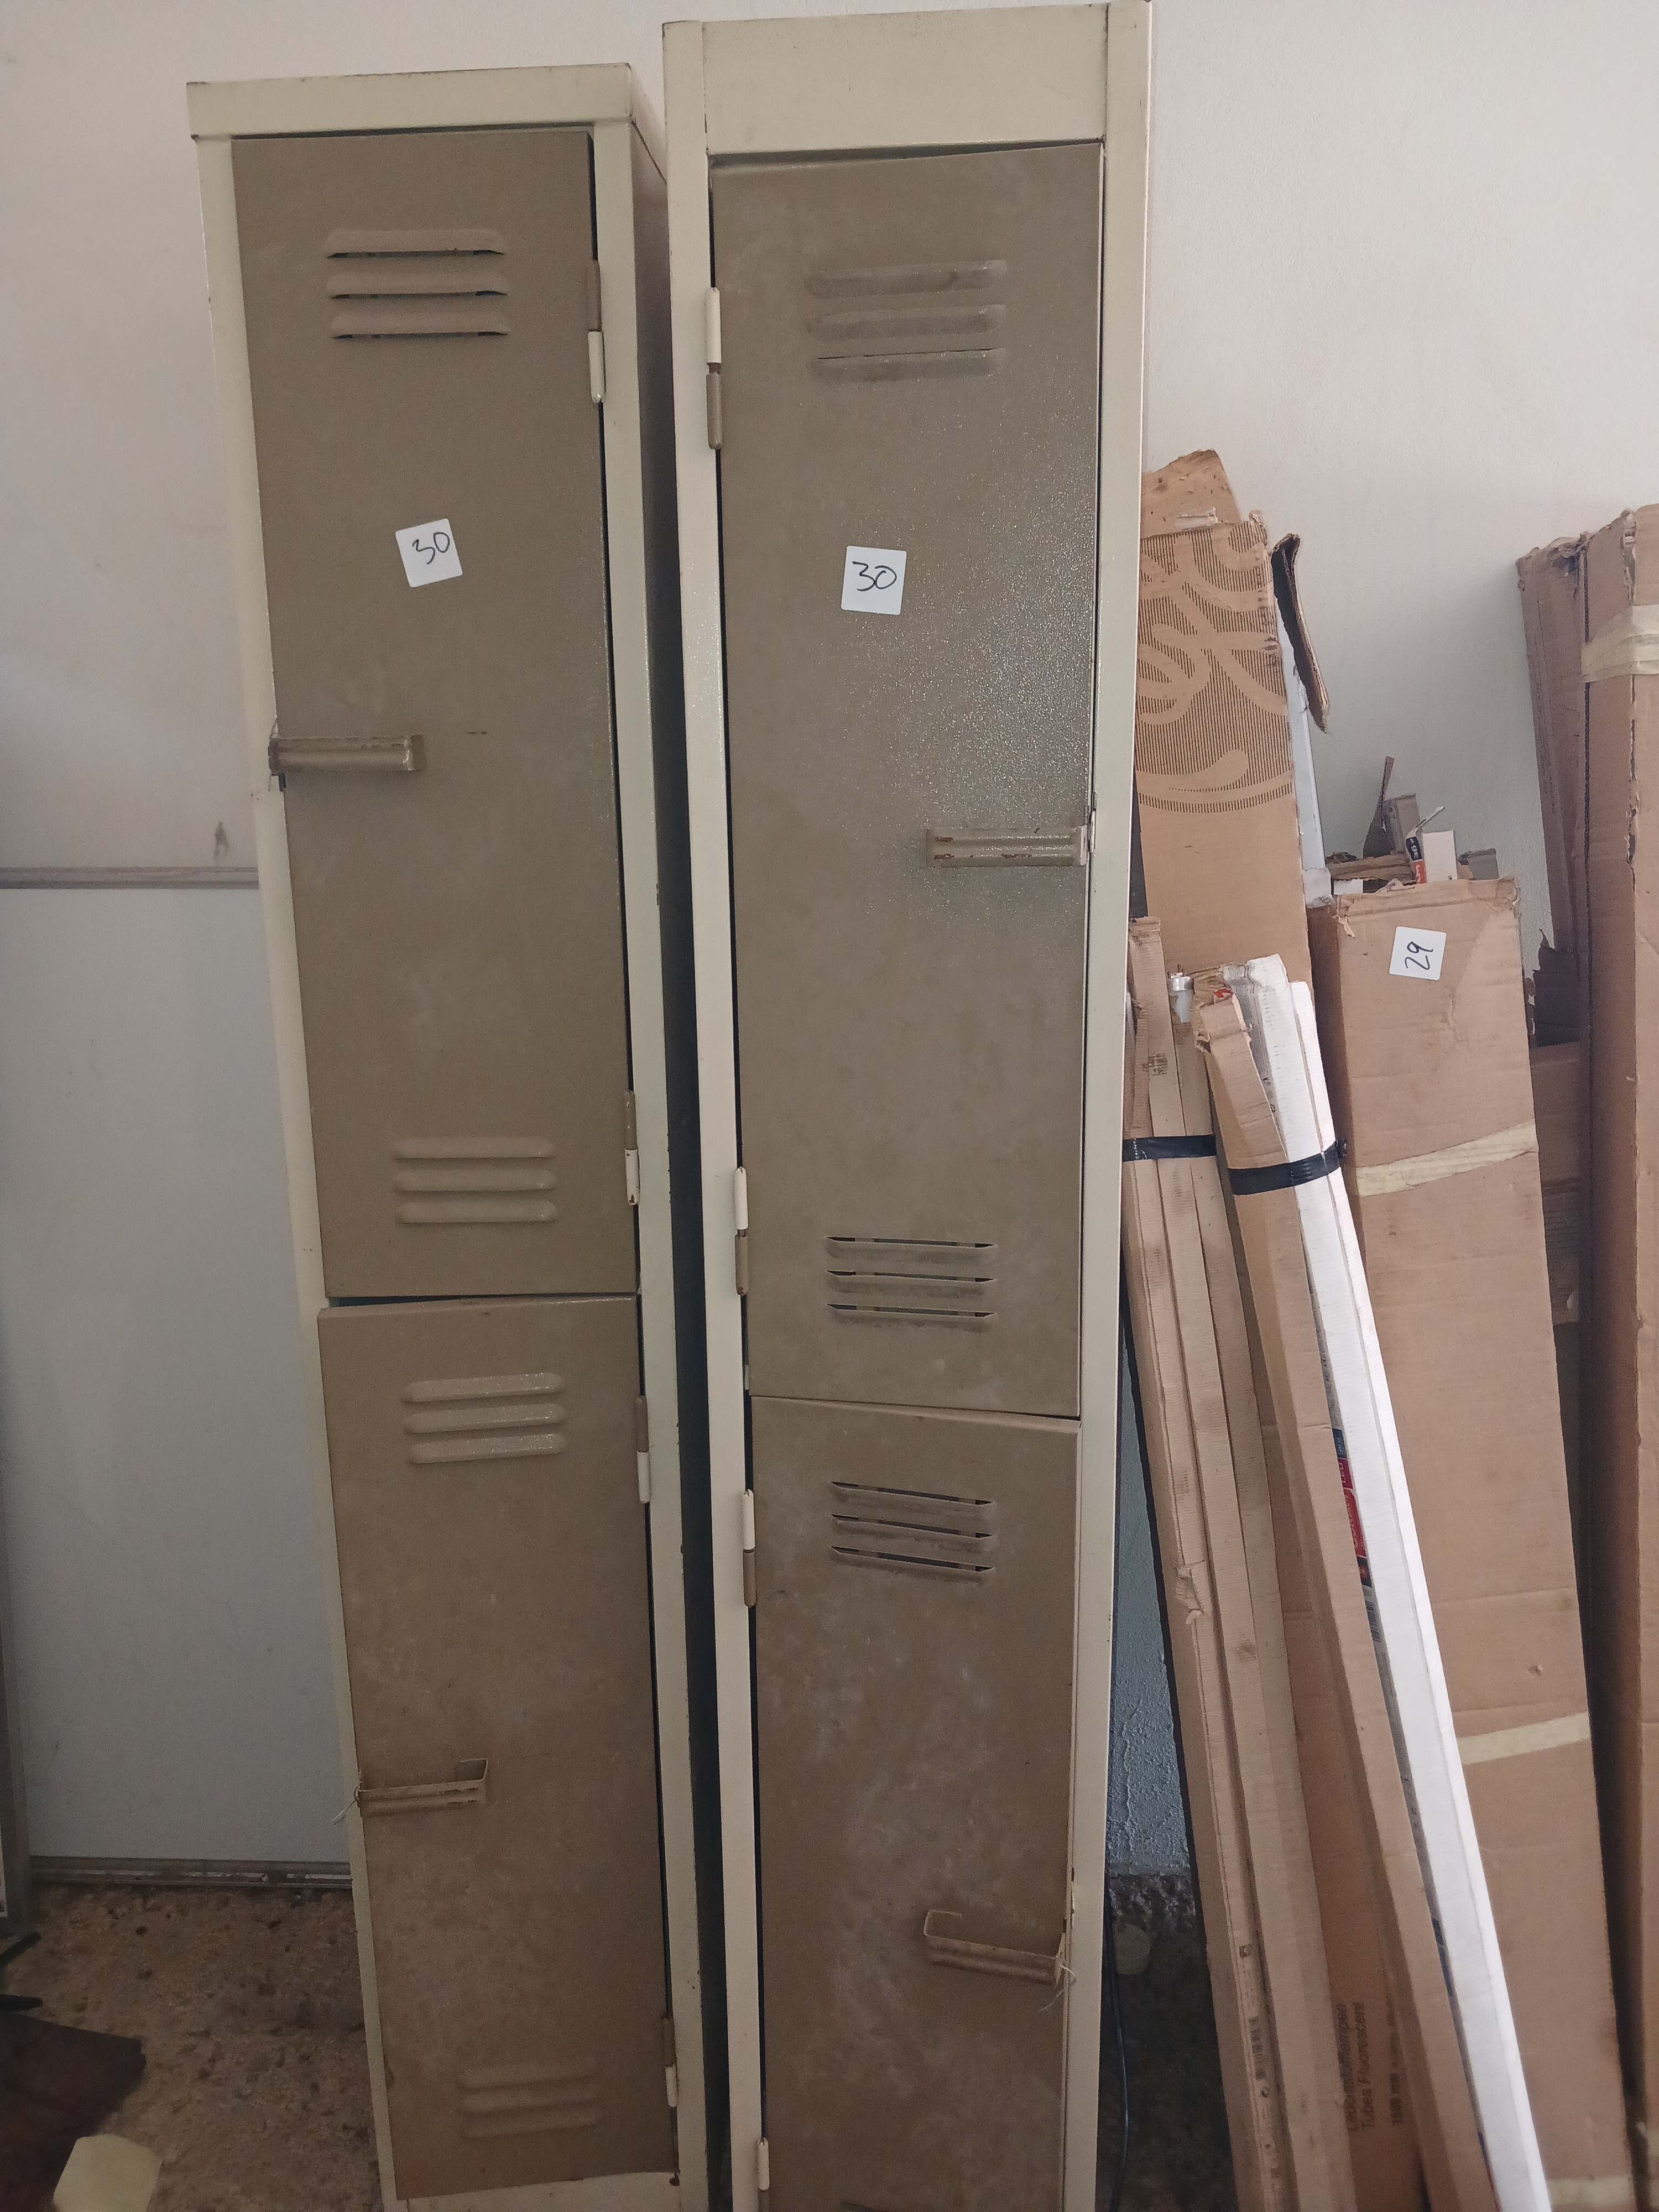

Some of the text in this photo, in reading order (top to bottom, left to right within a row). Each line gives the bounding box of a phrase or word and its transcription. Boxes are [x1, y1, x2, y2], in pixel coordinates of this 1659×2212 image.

[412, 531, 450, 565] 30
[852, 561, 897, 592] 30
[1405, 941, 1433, 970] 29
[1353, 2002, 1375, 2127] Tubes Fluorescent
